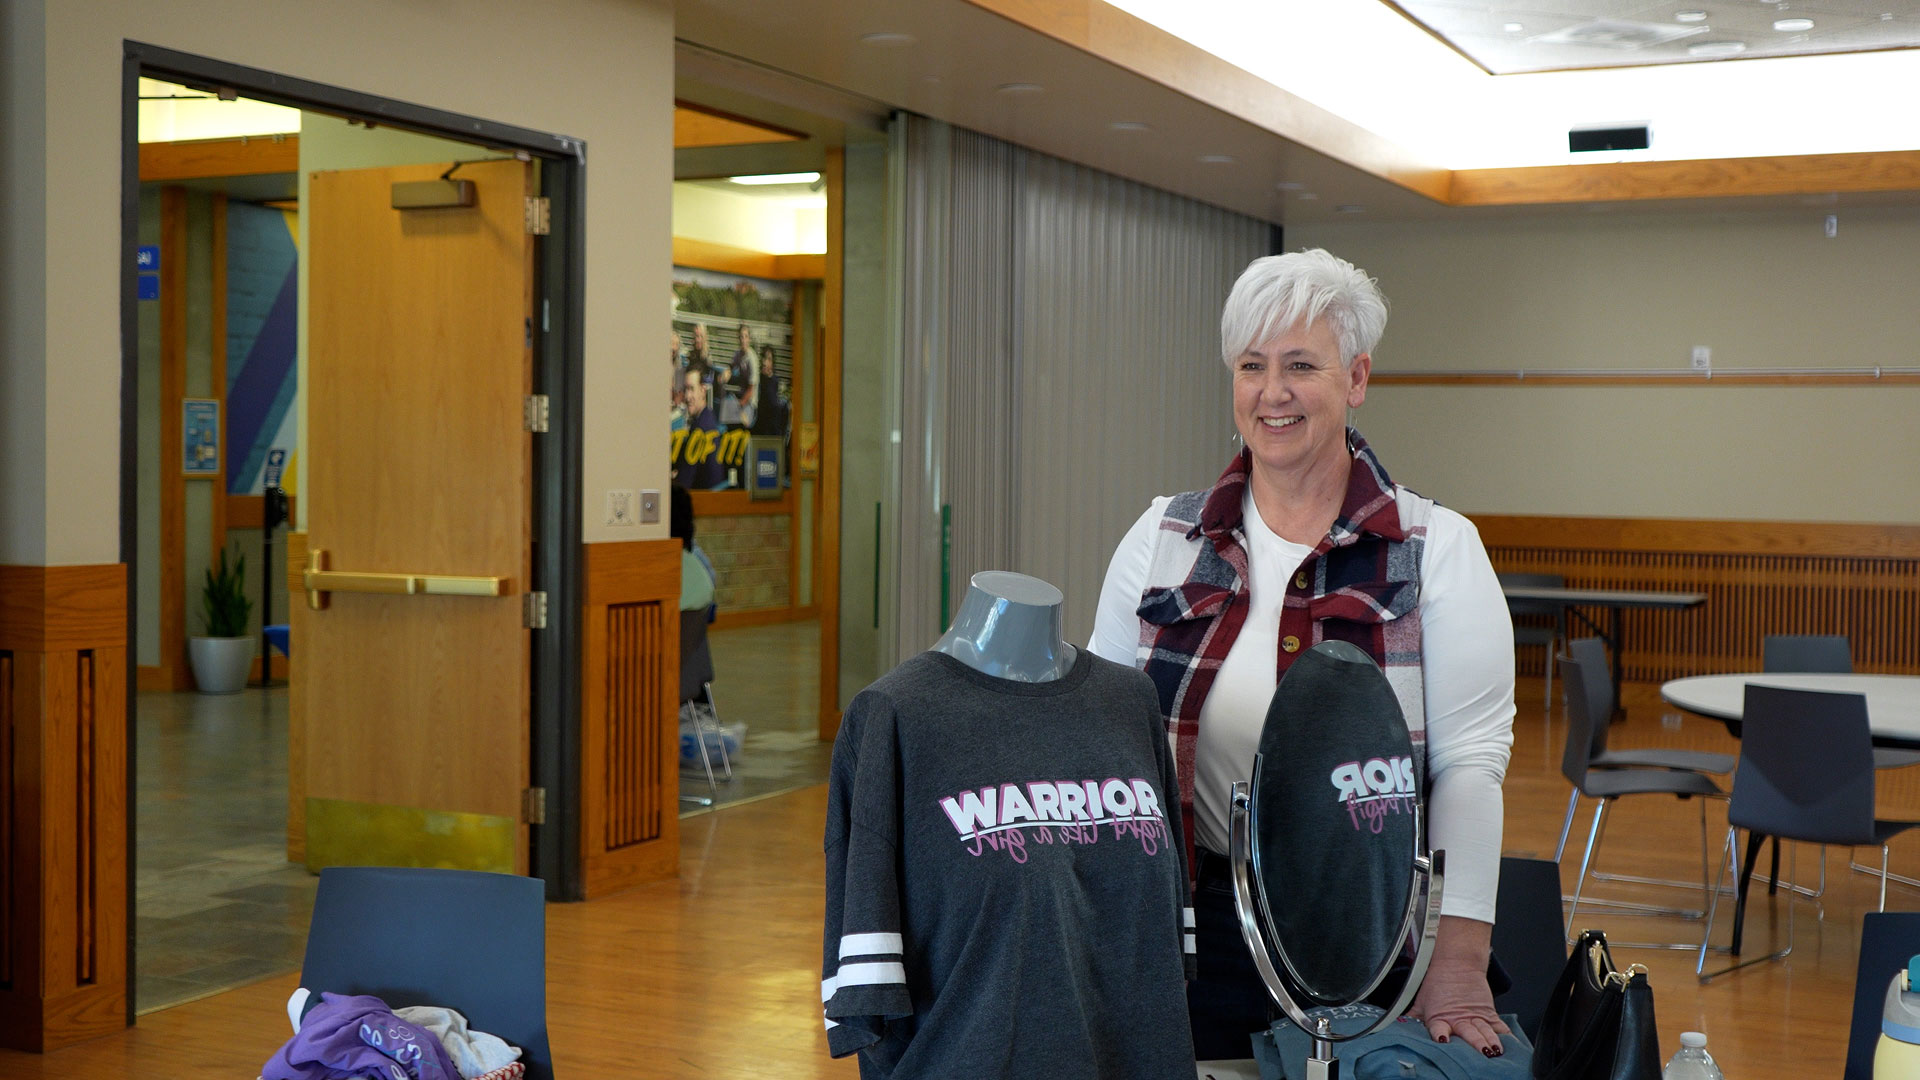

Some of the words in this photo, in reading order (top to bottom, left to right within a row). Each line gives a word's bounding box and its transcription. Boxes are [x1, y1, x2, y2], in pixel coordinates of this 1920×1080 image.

[671, 429, 689, 464] T
[685, 428, 720, 465] OF
[717, 428, 751, 466] IT!
[939, 777, 1164, 835] WARRIOR
[1347, 786, 1400, 833] fight
